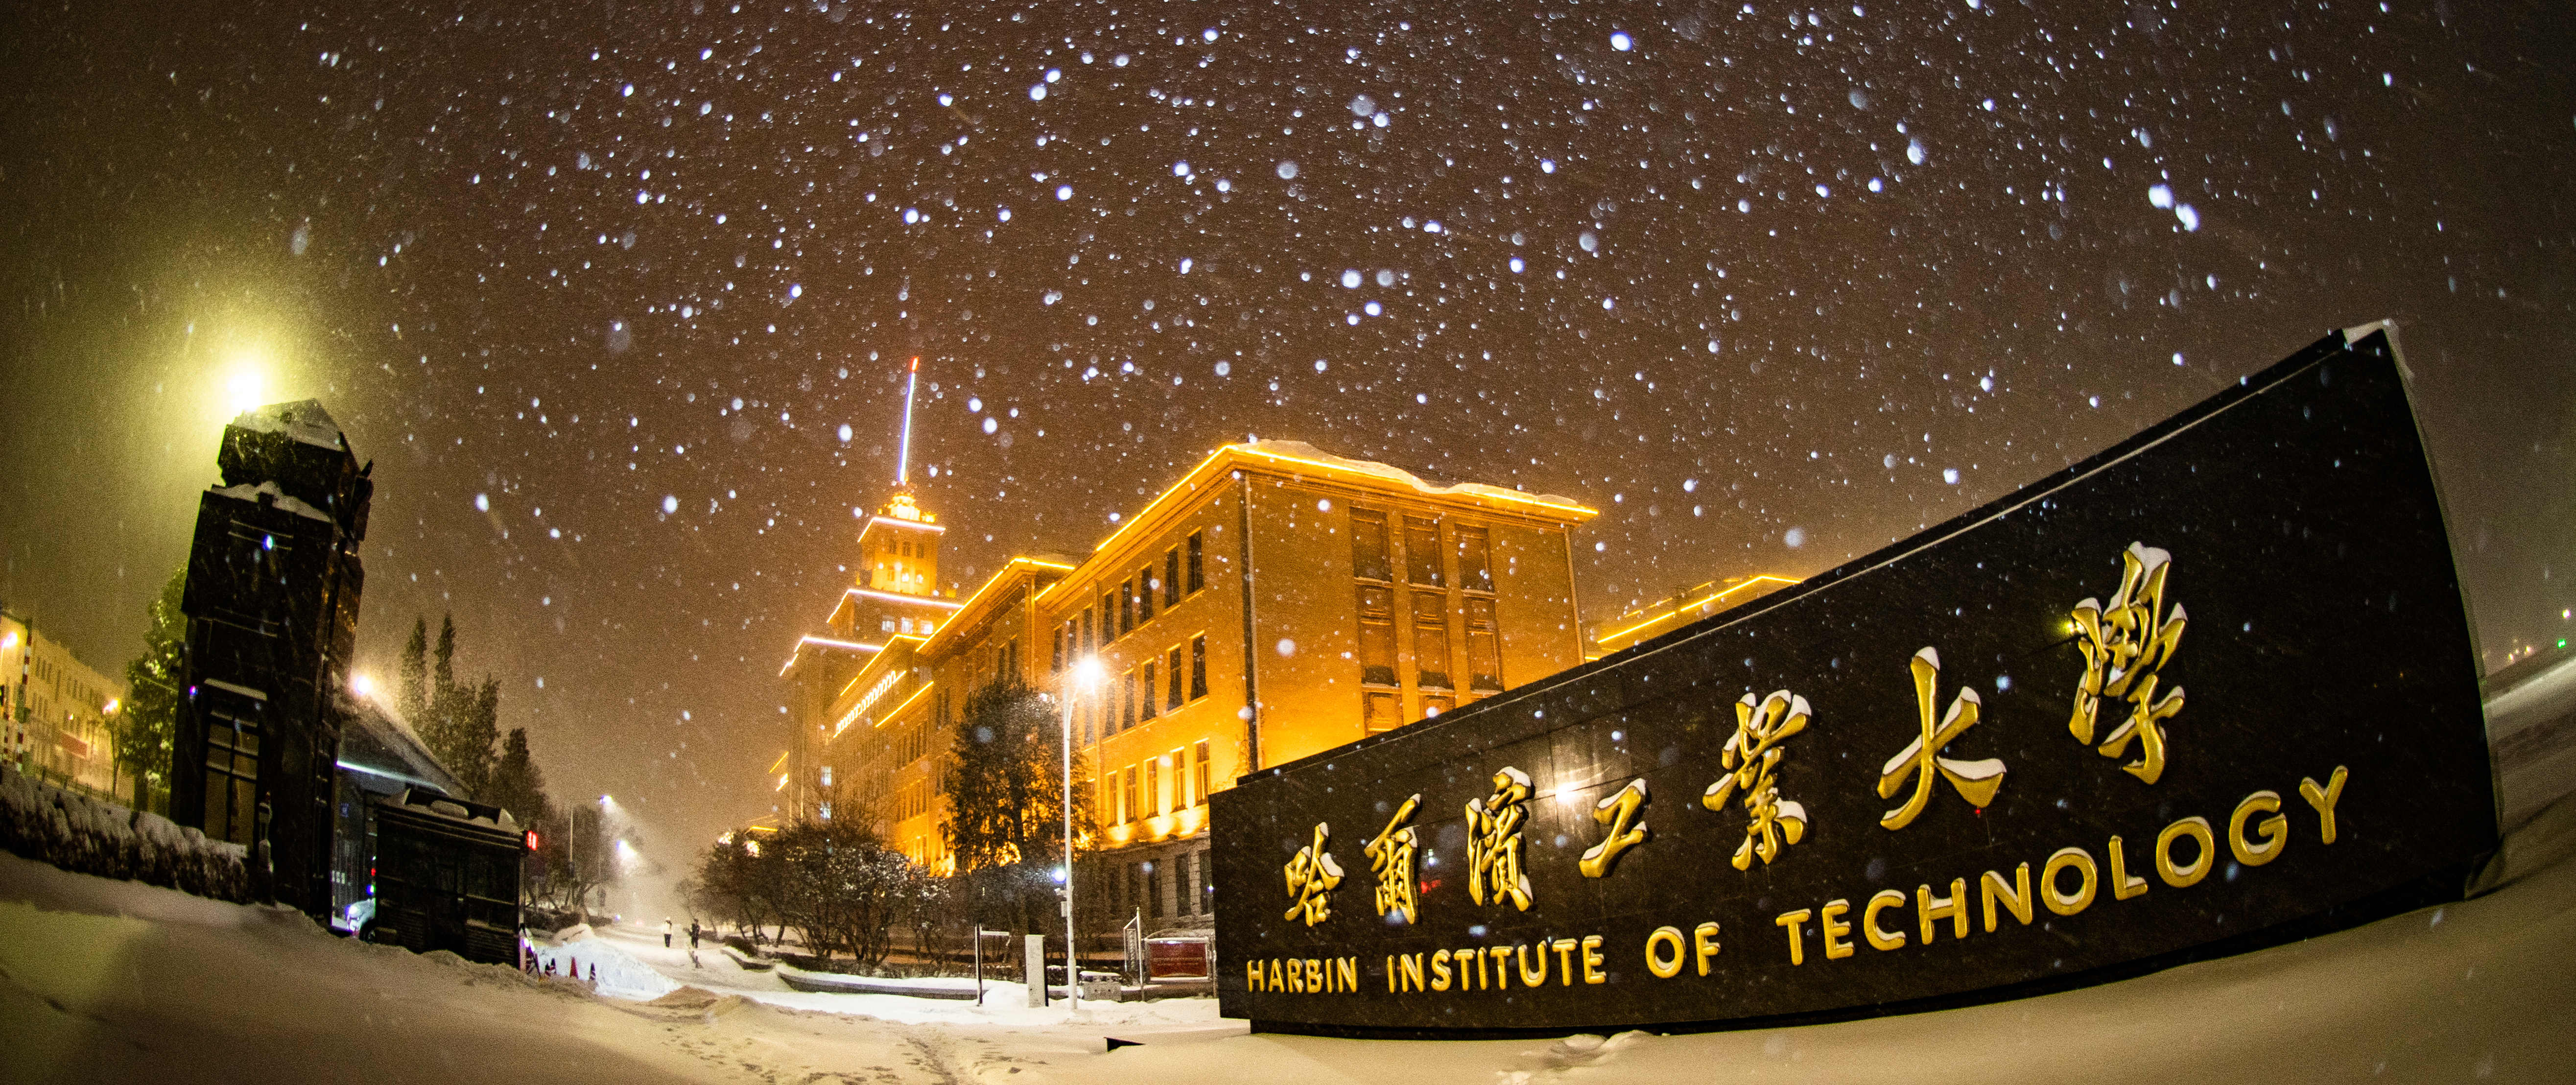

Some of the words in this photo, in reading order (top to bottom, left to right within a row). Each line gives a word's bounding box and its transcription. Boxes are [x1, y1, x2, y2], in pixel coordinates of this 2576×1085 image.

[1247, 956, 1358, 993] HARBIN
[1386, 935, 1607, 993] INSTITUTE
[1645, 921, 1721, 978] OF
[1775, 765, 2349, 966] TECHNOLOGY
